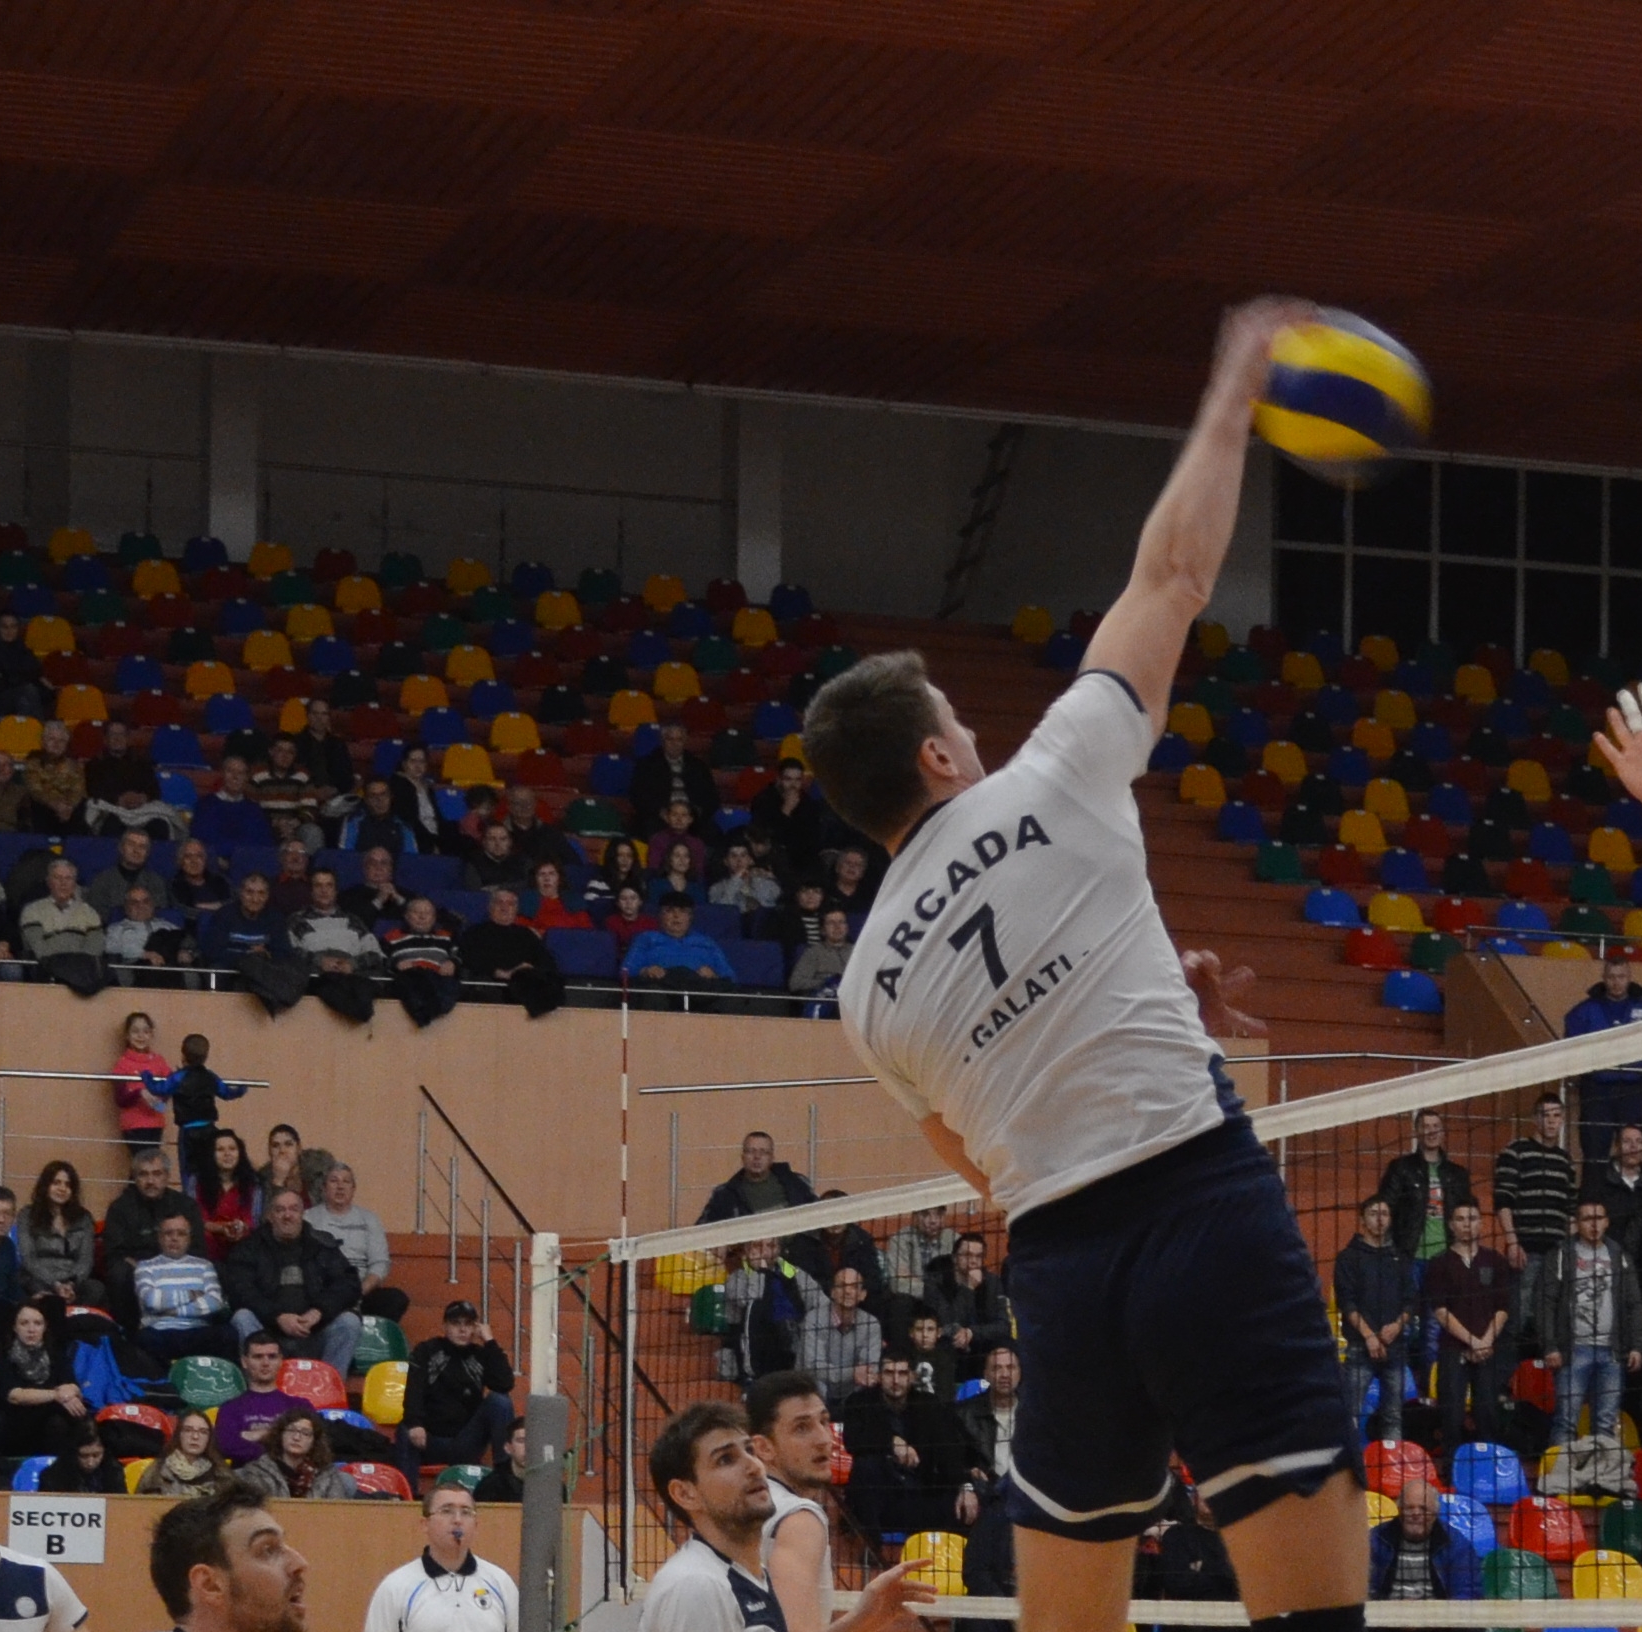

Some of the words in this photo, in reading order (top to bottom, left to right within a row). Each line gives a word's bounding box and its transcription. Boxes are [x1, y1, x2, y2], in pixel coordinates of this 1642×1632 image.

[876, 814, 1052, 1001] ARCADA
[947, 902, 1009, 990] 7
[11, 1510, 102, 1528] SECTOR
[46, 1534, 65, 1555] B
